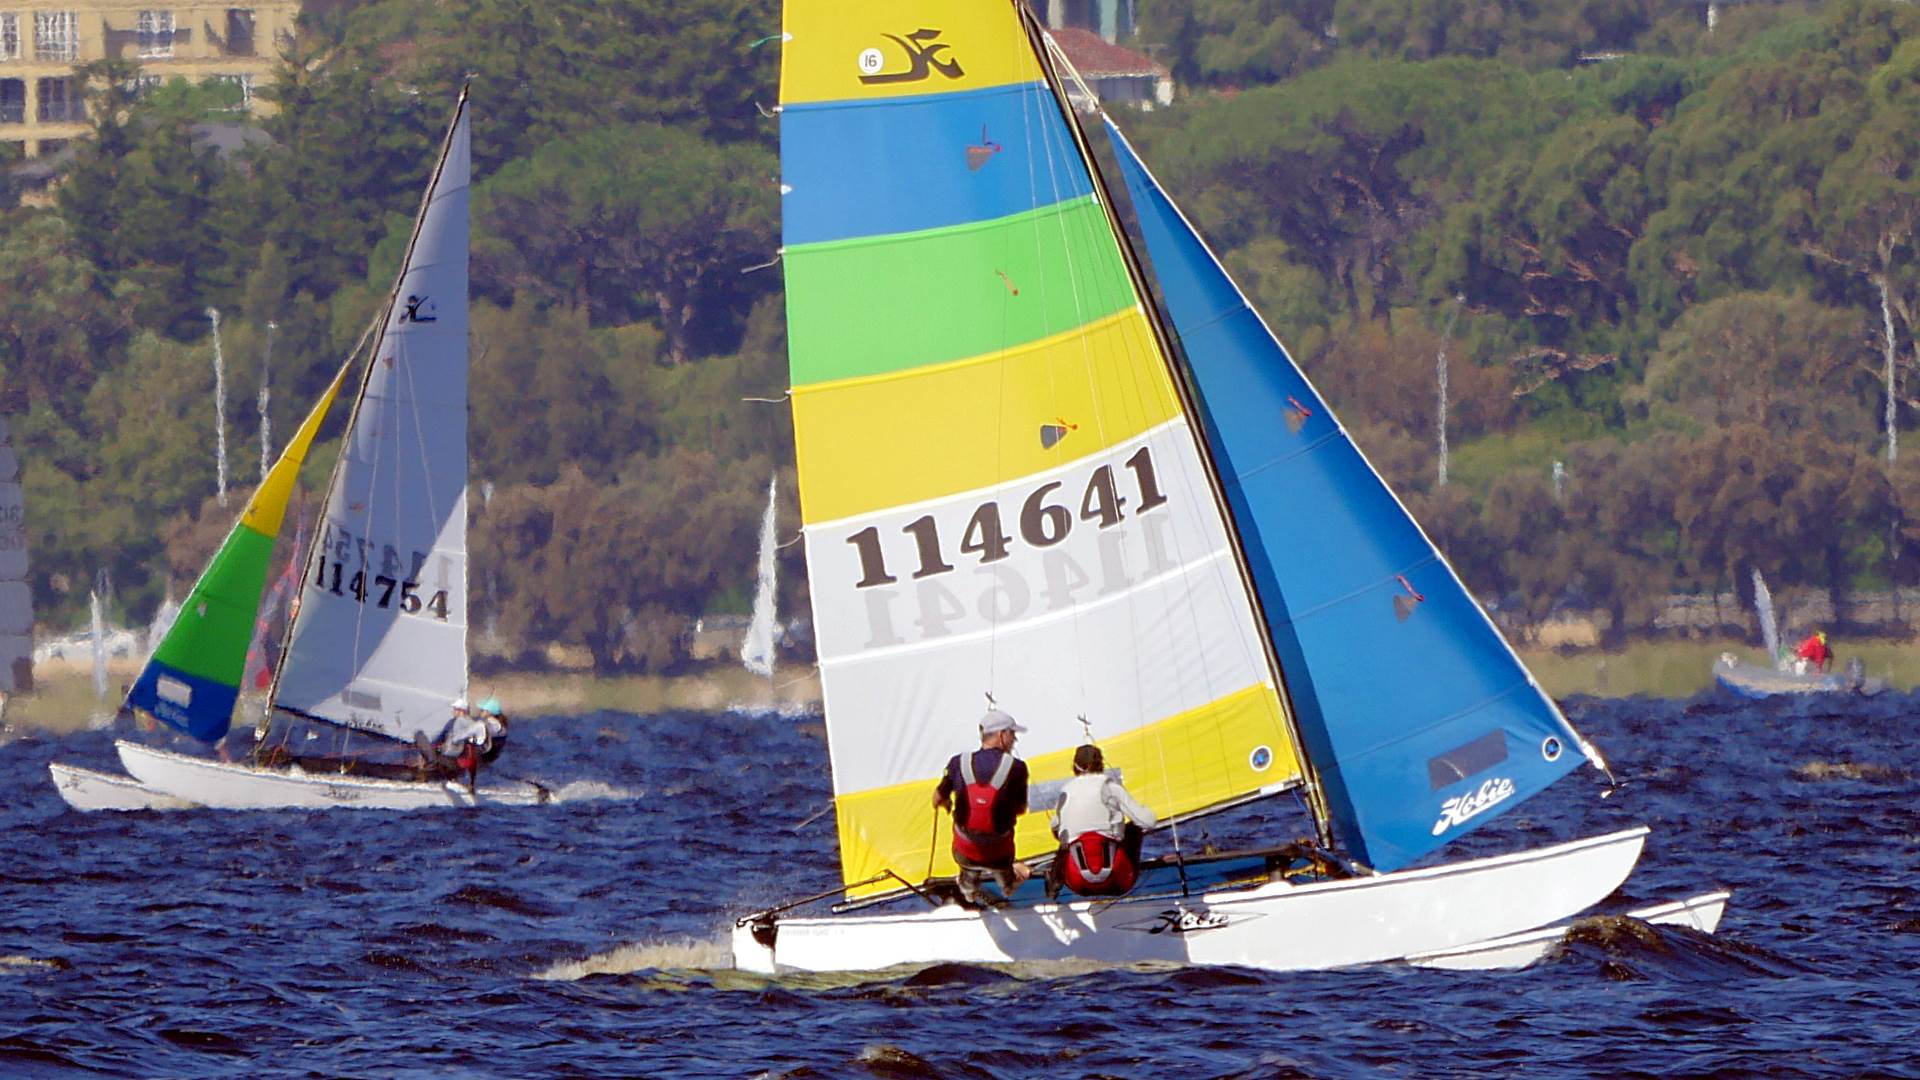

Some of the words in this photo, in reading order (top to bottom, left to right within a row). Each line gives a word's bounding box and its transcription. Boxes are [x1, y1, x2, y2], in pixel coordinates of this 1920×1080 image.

[864, 54, 878, 68] 16
[846, 446, 1168, 589] 114641
[315, 555, 452, 622] 114754
[1432, 778, 1515, 836] Hobie
[1149, 908, 1229, 934] Hobie
